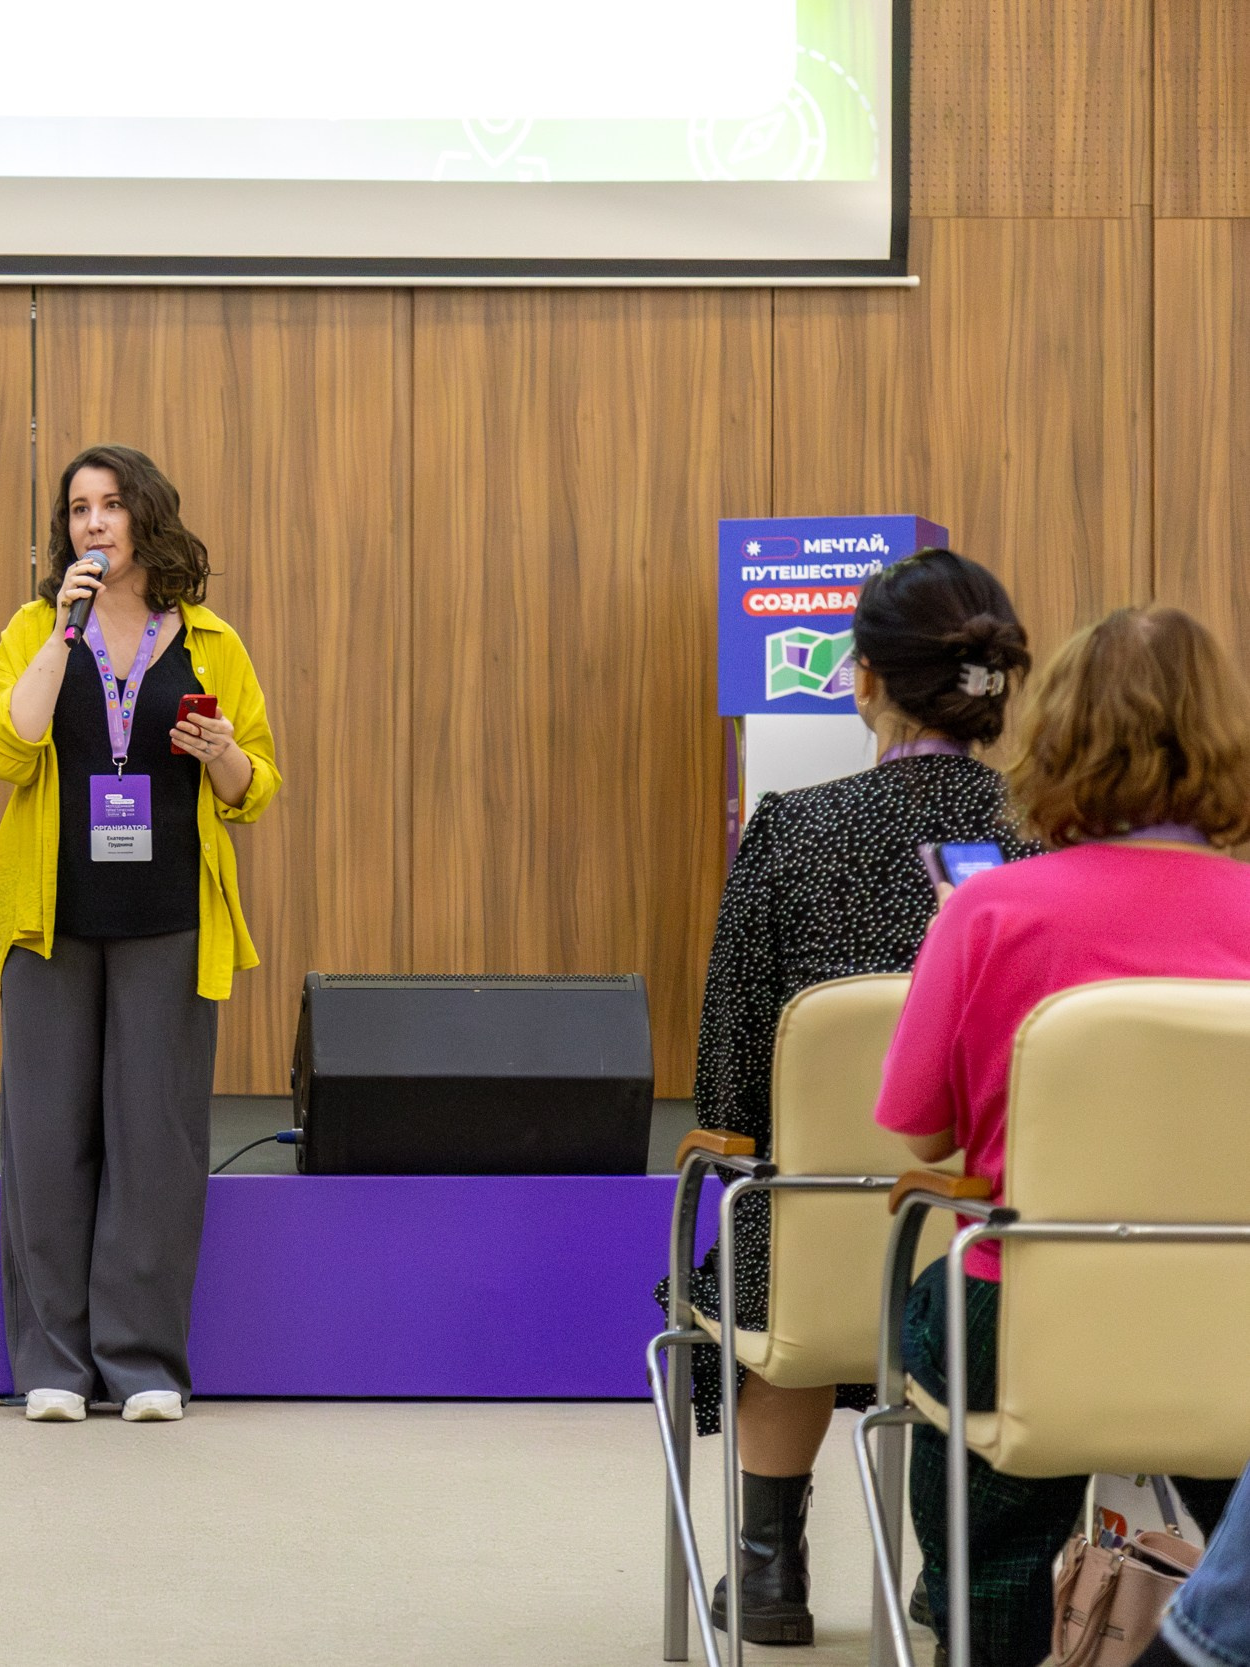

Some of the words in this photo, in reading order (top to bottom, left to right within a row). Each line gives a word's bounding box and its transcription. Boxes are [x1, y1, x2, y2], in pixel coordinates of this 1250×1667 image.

[803, 534, 890, 555] МЕЧТАЙ,
[741, 559, 883, 581] ПУТЕШЕСТВУЙ
[749, 592, 858, 612] СОЗДАВА
